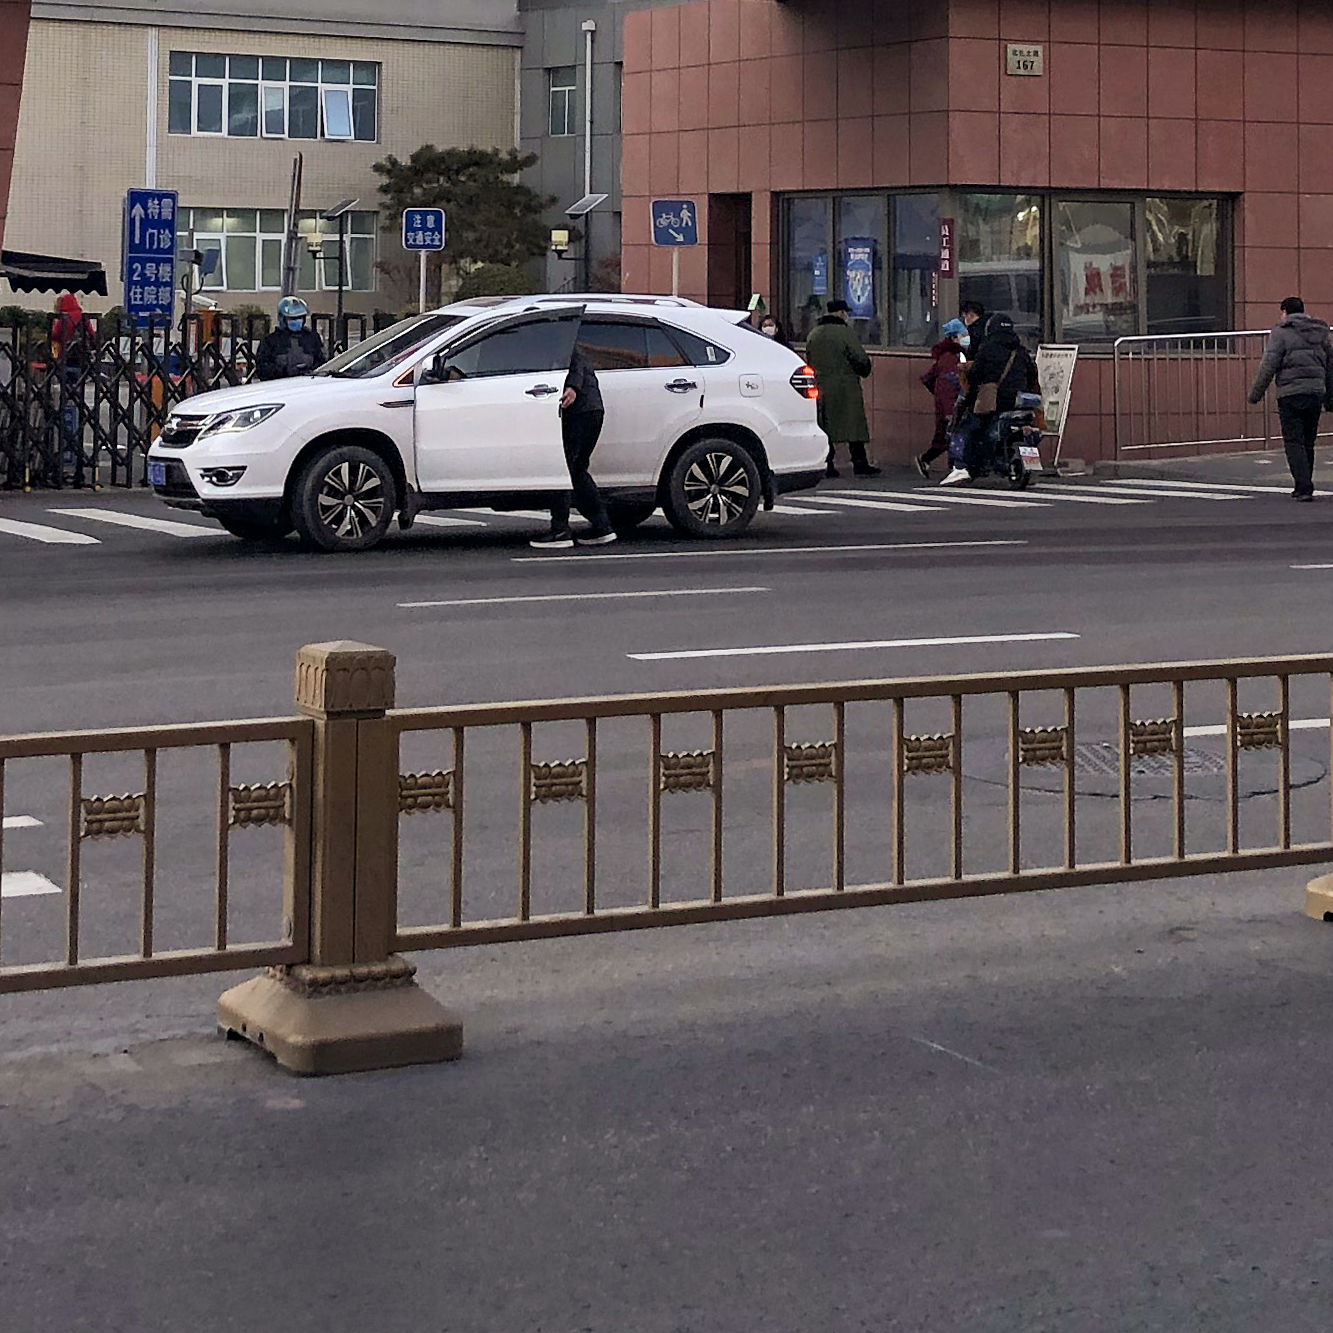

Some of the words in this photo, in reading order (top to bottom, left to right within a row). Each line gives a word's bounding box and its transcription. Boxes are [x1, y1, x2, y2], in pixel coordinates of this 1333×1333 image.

[1015, 59, 1035, 71] 167
[147, 197, 174, 221] 特需
[145, 227, 173, 250] 门诊
[406, 230, 442, 246] 交通安全
[131, 262, 173, 282] 2号楼
[129, 284, 173, 306] 住院部
